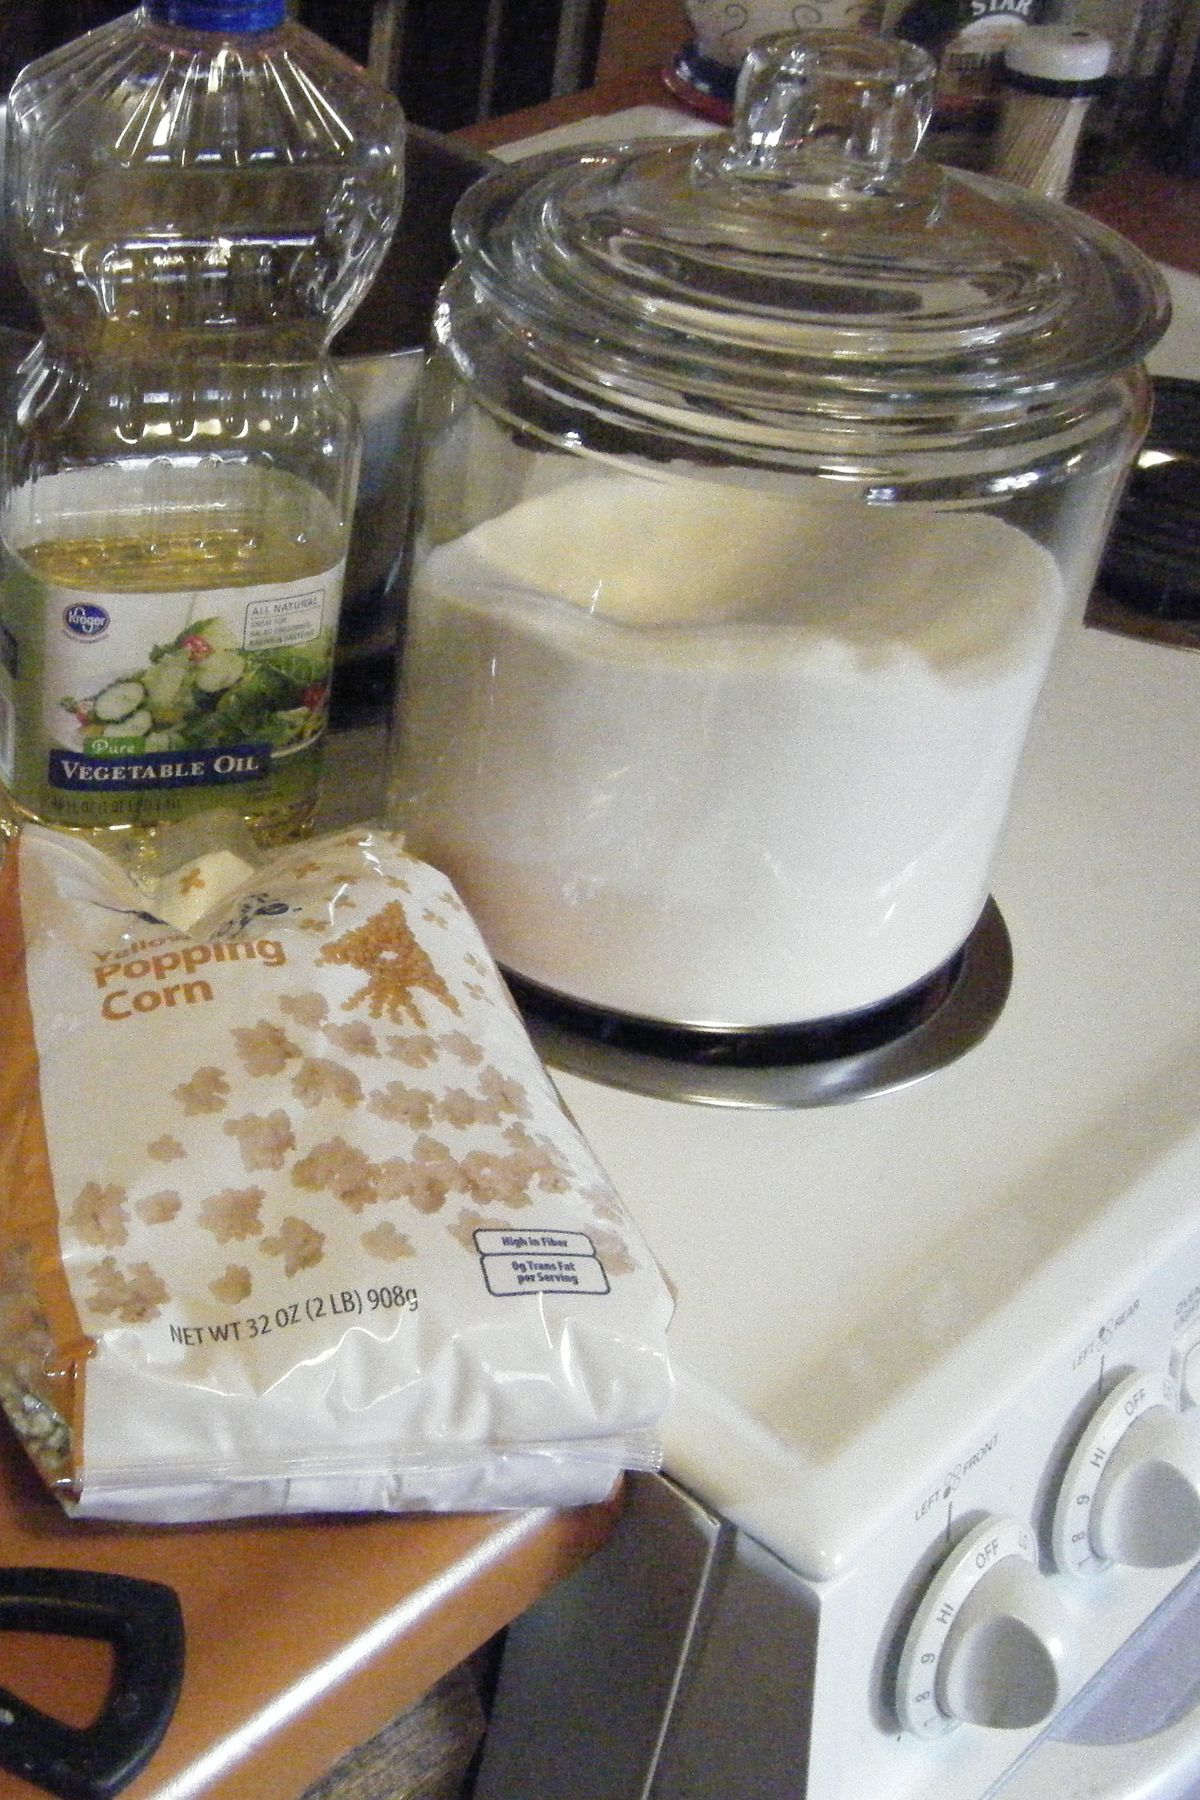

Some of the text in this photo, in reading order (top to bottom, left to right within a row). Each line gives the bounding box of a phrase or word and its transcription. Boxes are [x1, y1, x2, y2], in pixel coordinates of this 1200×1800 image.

[68, 607, 105, 633] Kroger
[91, 738, 136, 755] Pure
[61, 755, 260, 781] VEGETABLE OIL
[94, 939, 288, 988] Popping
[101, 980, 214, 1021] Corn
[502, 1236, 568, 1249] High in Fiber
[527, 1260, 557, 1272] Trans
[557, 1261, 577, 1272] Fat
[536, 1272, 579, 1286] Serving
[170, 1286, 420, 1346] NET WT 32 OZ (2 LB) 908g
[1125, 1387, 1146, 1417] OFF
[1090, 1446, 1107, 1468] HI
[915, 1433, 1000, 1521] LEFT FRONT
[975, 1537, 1000, 1570] OFF
[936, 1603, 955, 1626] HI
